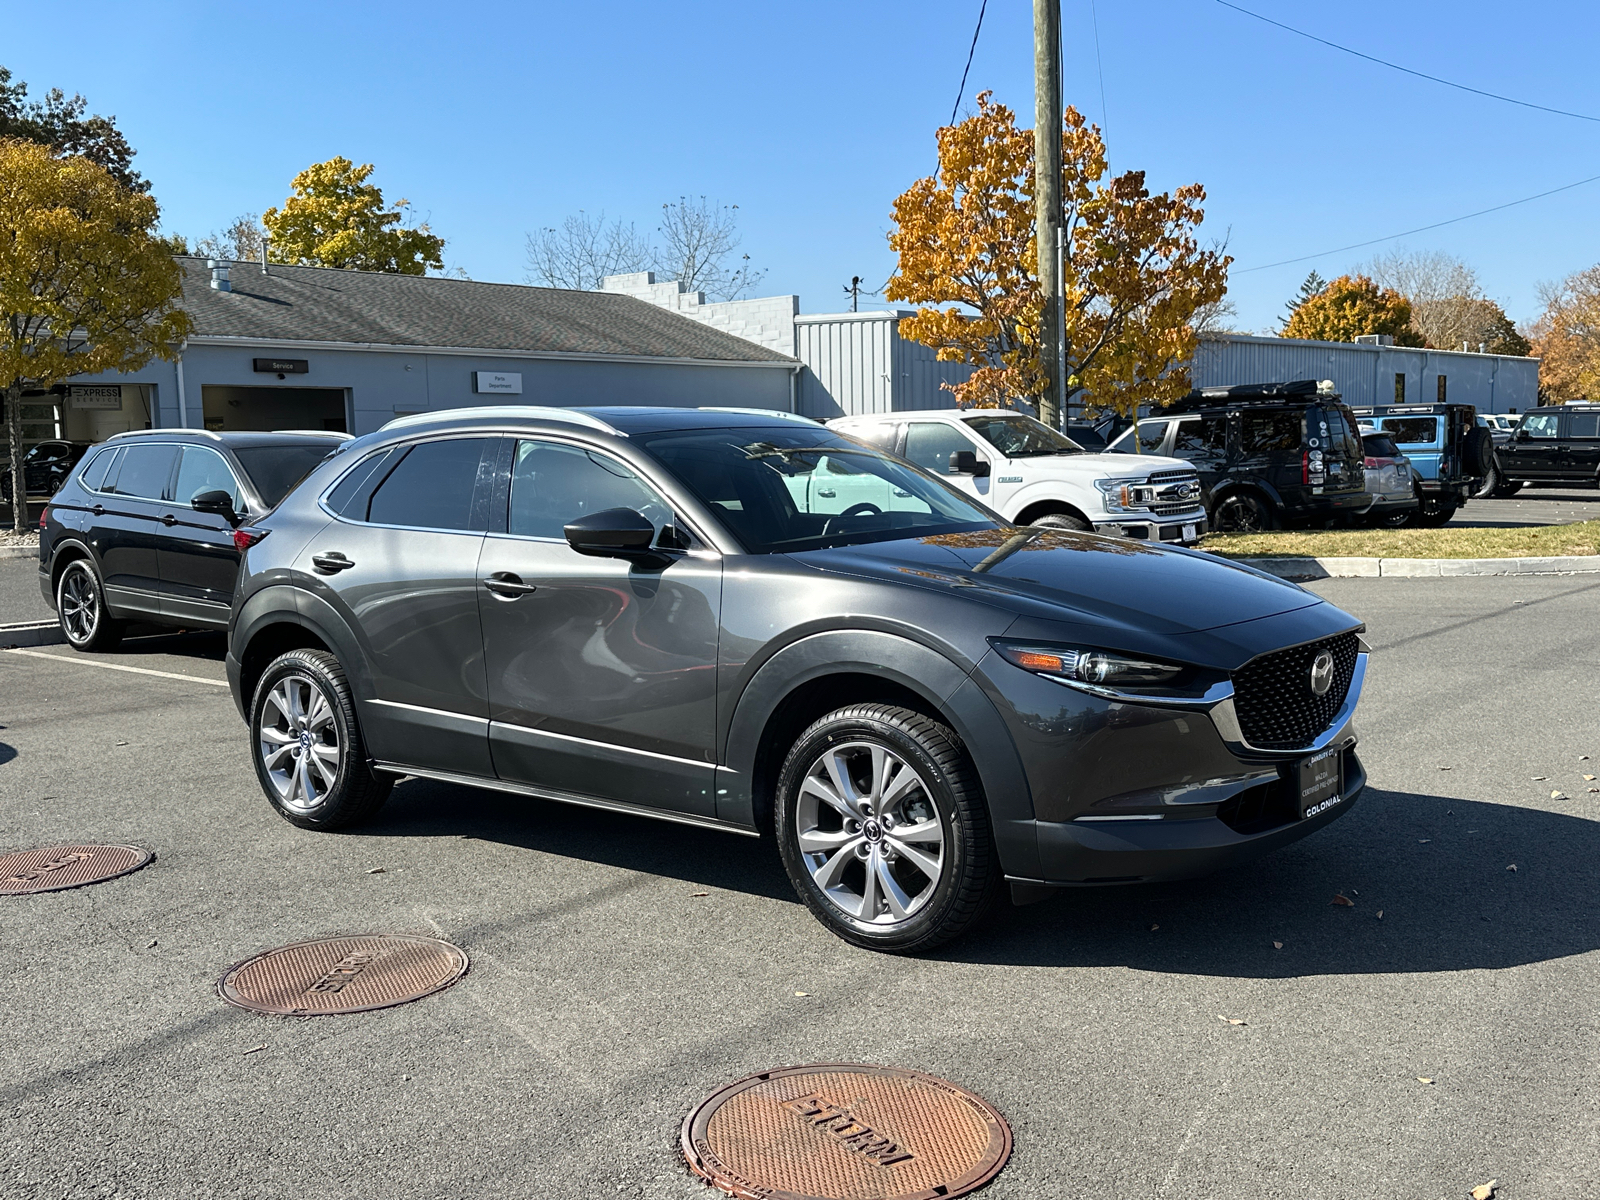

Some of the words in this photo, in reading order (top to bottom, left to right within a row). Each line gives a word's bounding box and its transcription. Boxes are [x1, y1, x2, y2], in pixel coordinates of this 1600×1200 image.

[272, 362, 294, 370] Service
[73, 388, 118, 397] EXPRESS
[1315, 771, 1329, 782] MAZDA
[1302, 783, 1320, 797] CERTIFIED
[1306, 795, 1341, 818] COLONIAL
[790, 1098, 914, 1166] STORM
